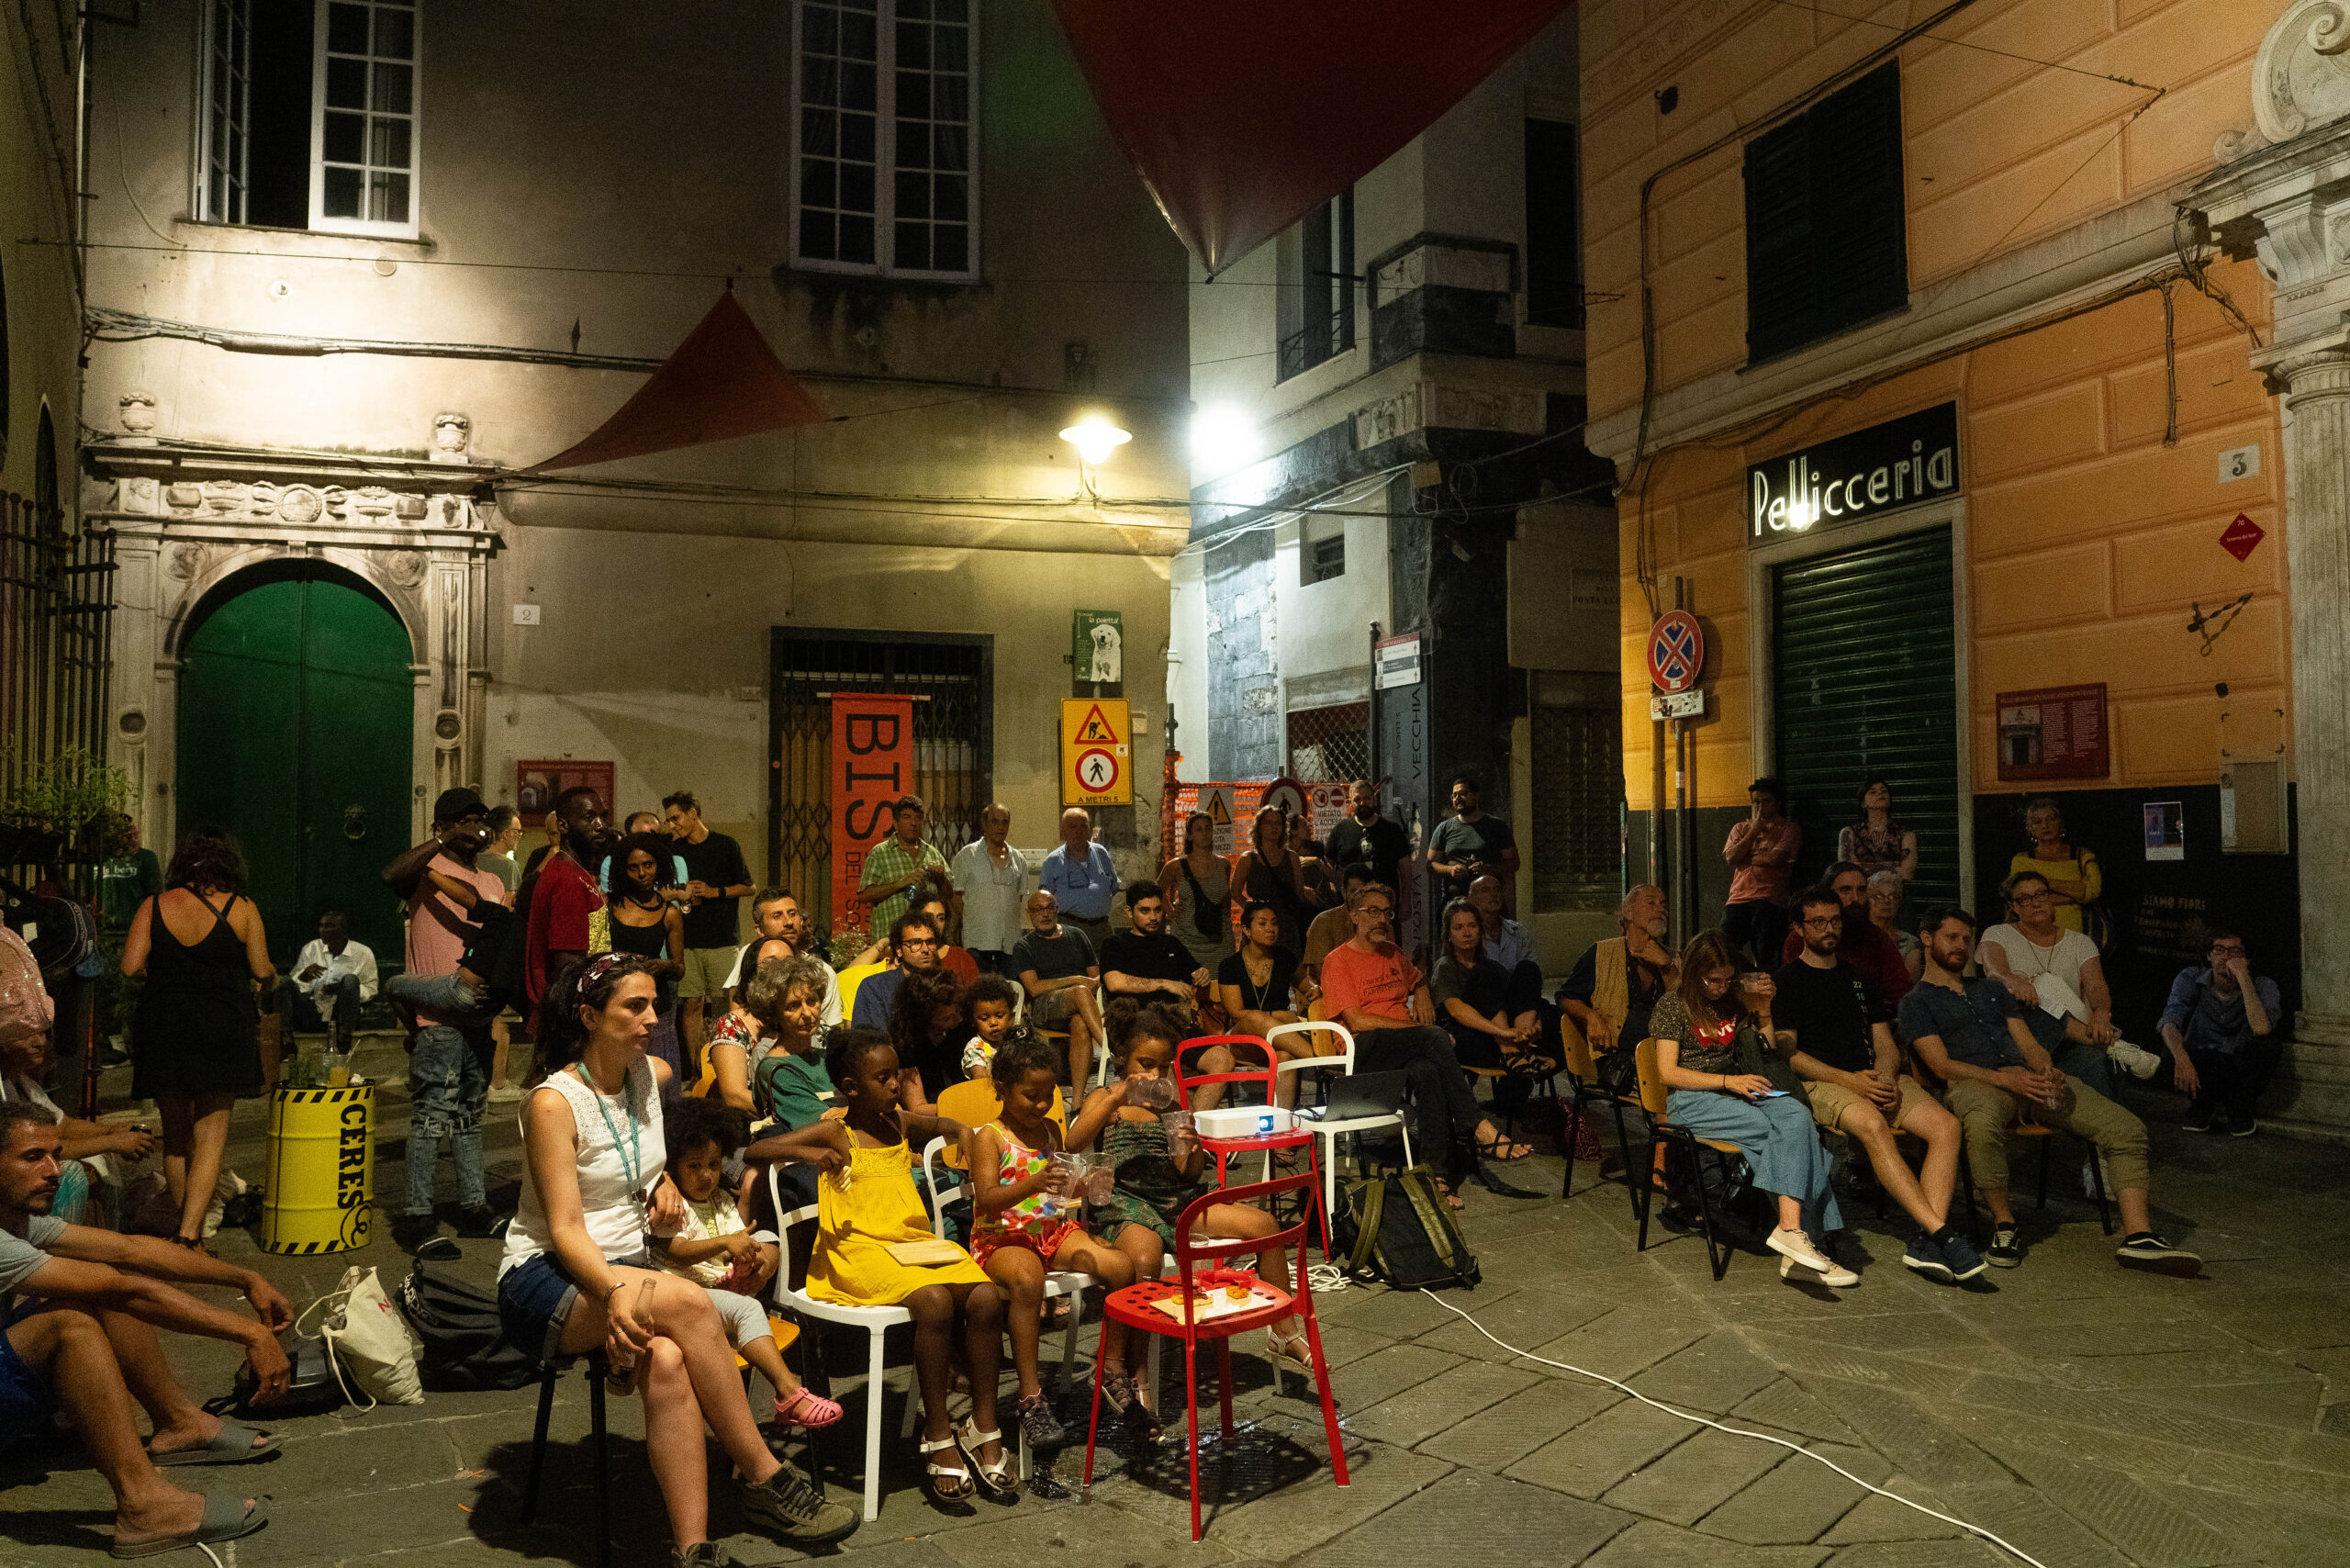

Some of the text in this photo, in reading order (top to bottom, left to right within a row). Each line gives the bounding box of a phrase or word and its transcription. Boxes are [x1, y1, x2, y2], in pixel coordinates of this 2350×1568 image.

[1754, 439, 1953, 536] Pellicceria
[2232, 453, 2247, 476] 3
[522, 610, 532, 621] 2
[1411, 689, 1422, 779] VECCHIA
[845, 713, 901, 841] BIS
[1317, 810, 1342, 818] VIETATO
[845, 851, 861, 885] DEL
[338, 1103, 367, 1210] CERES
